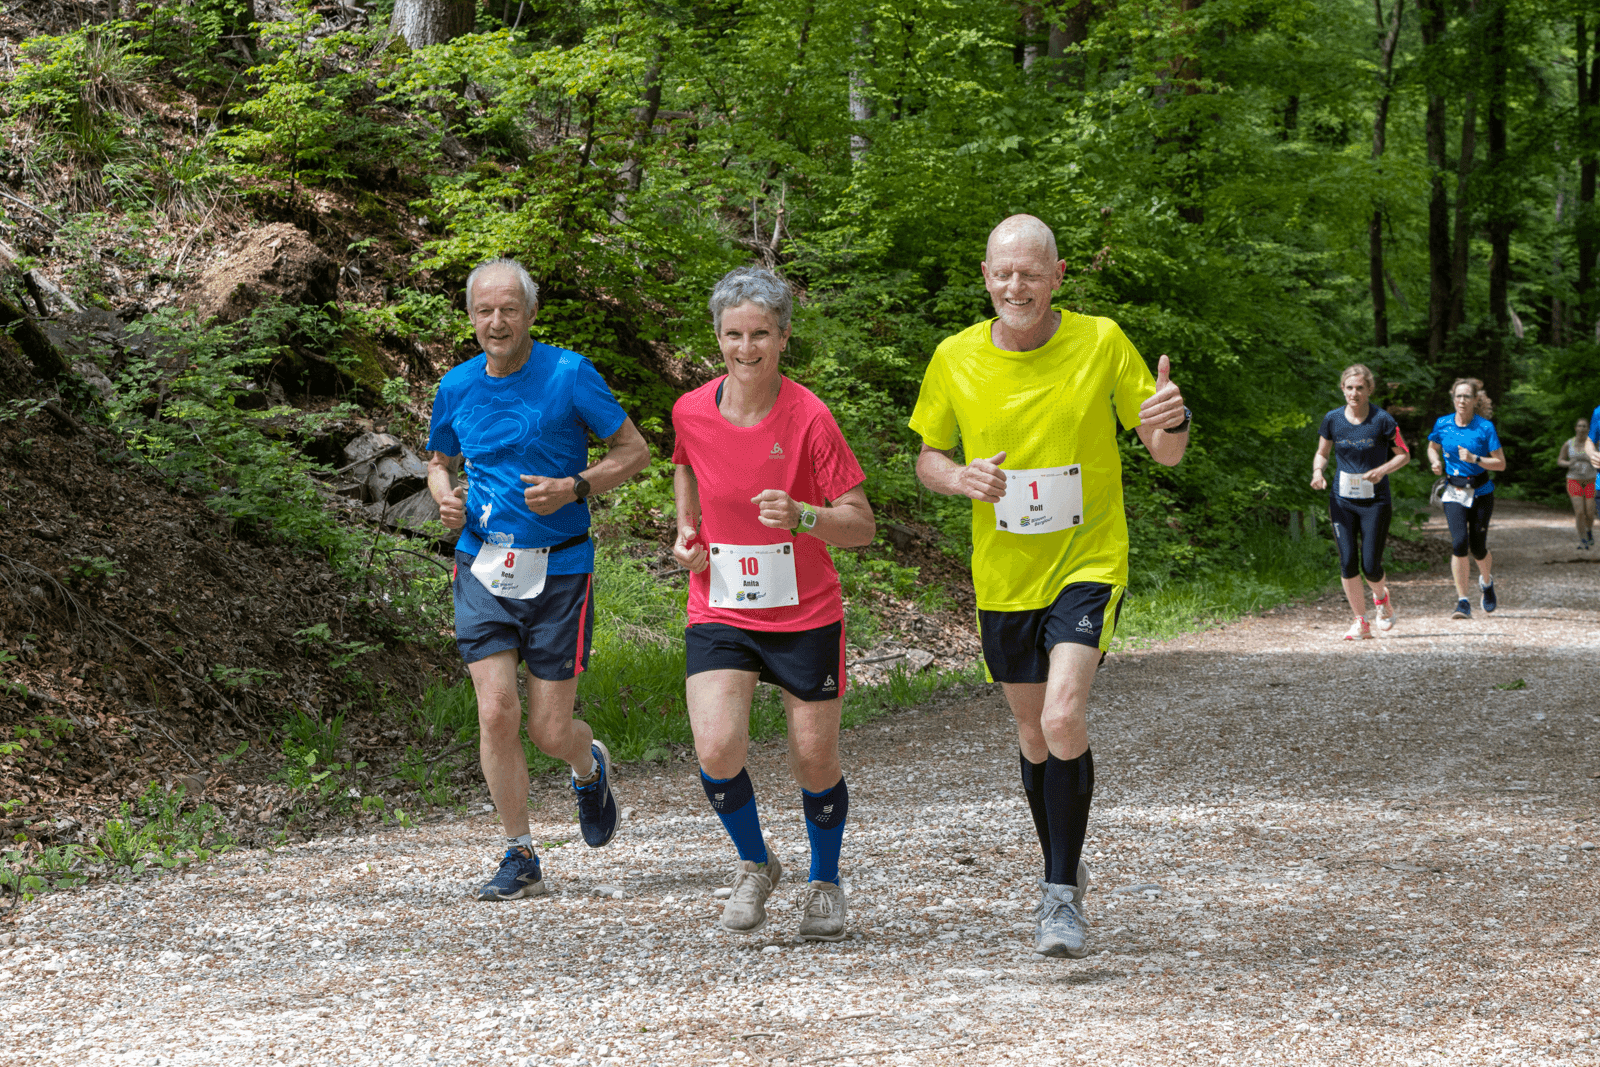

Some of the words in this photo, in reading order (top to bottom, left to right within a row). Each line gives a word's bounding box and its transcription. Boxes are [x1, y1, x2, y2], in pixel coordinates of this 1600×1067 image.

[1028, 480, 1039, 500] 1
[504, 551, 516, 569] 8
[738, 556, 759, 576] 10
